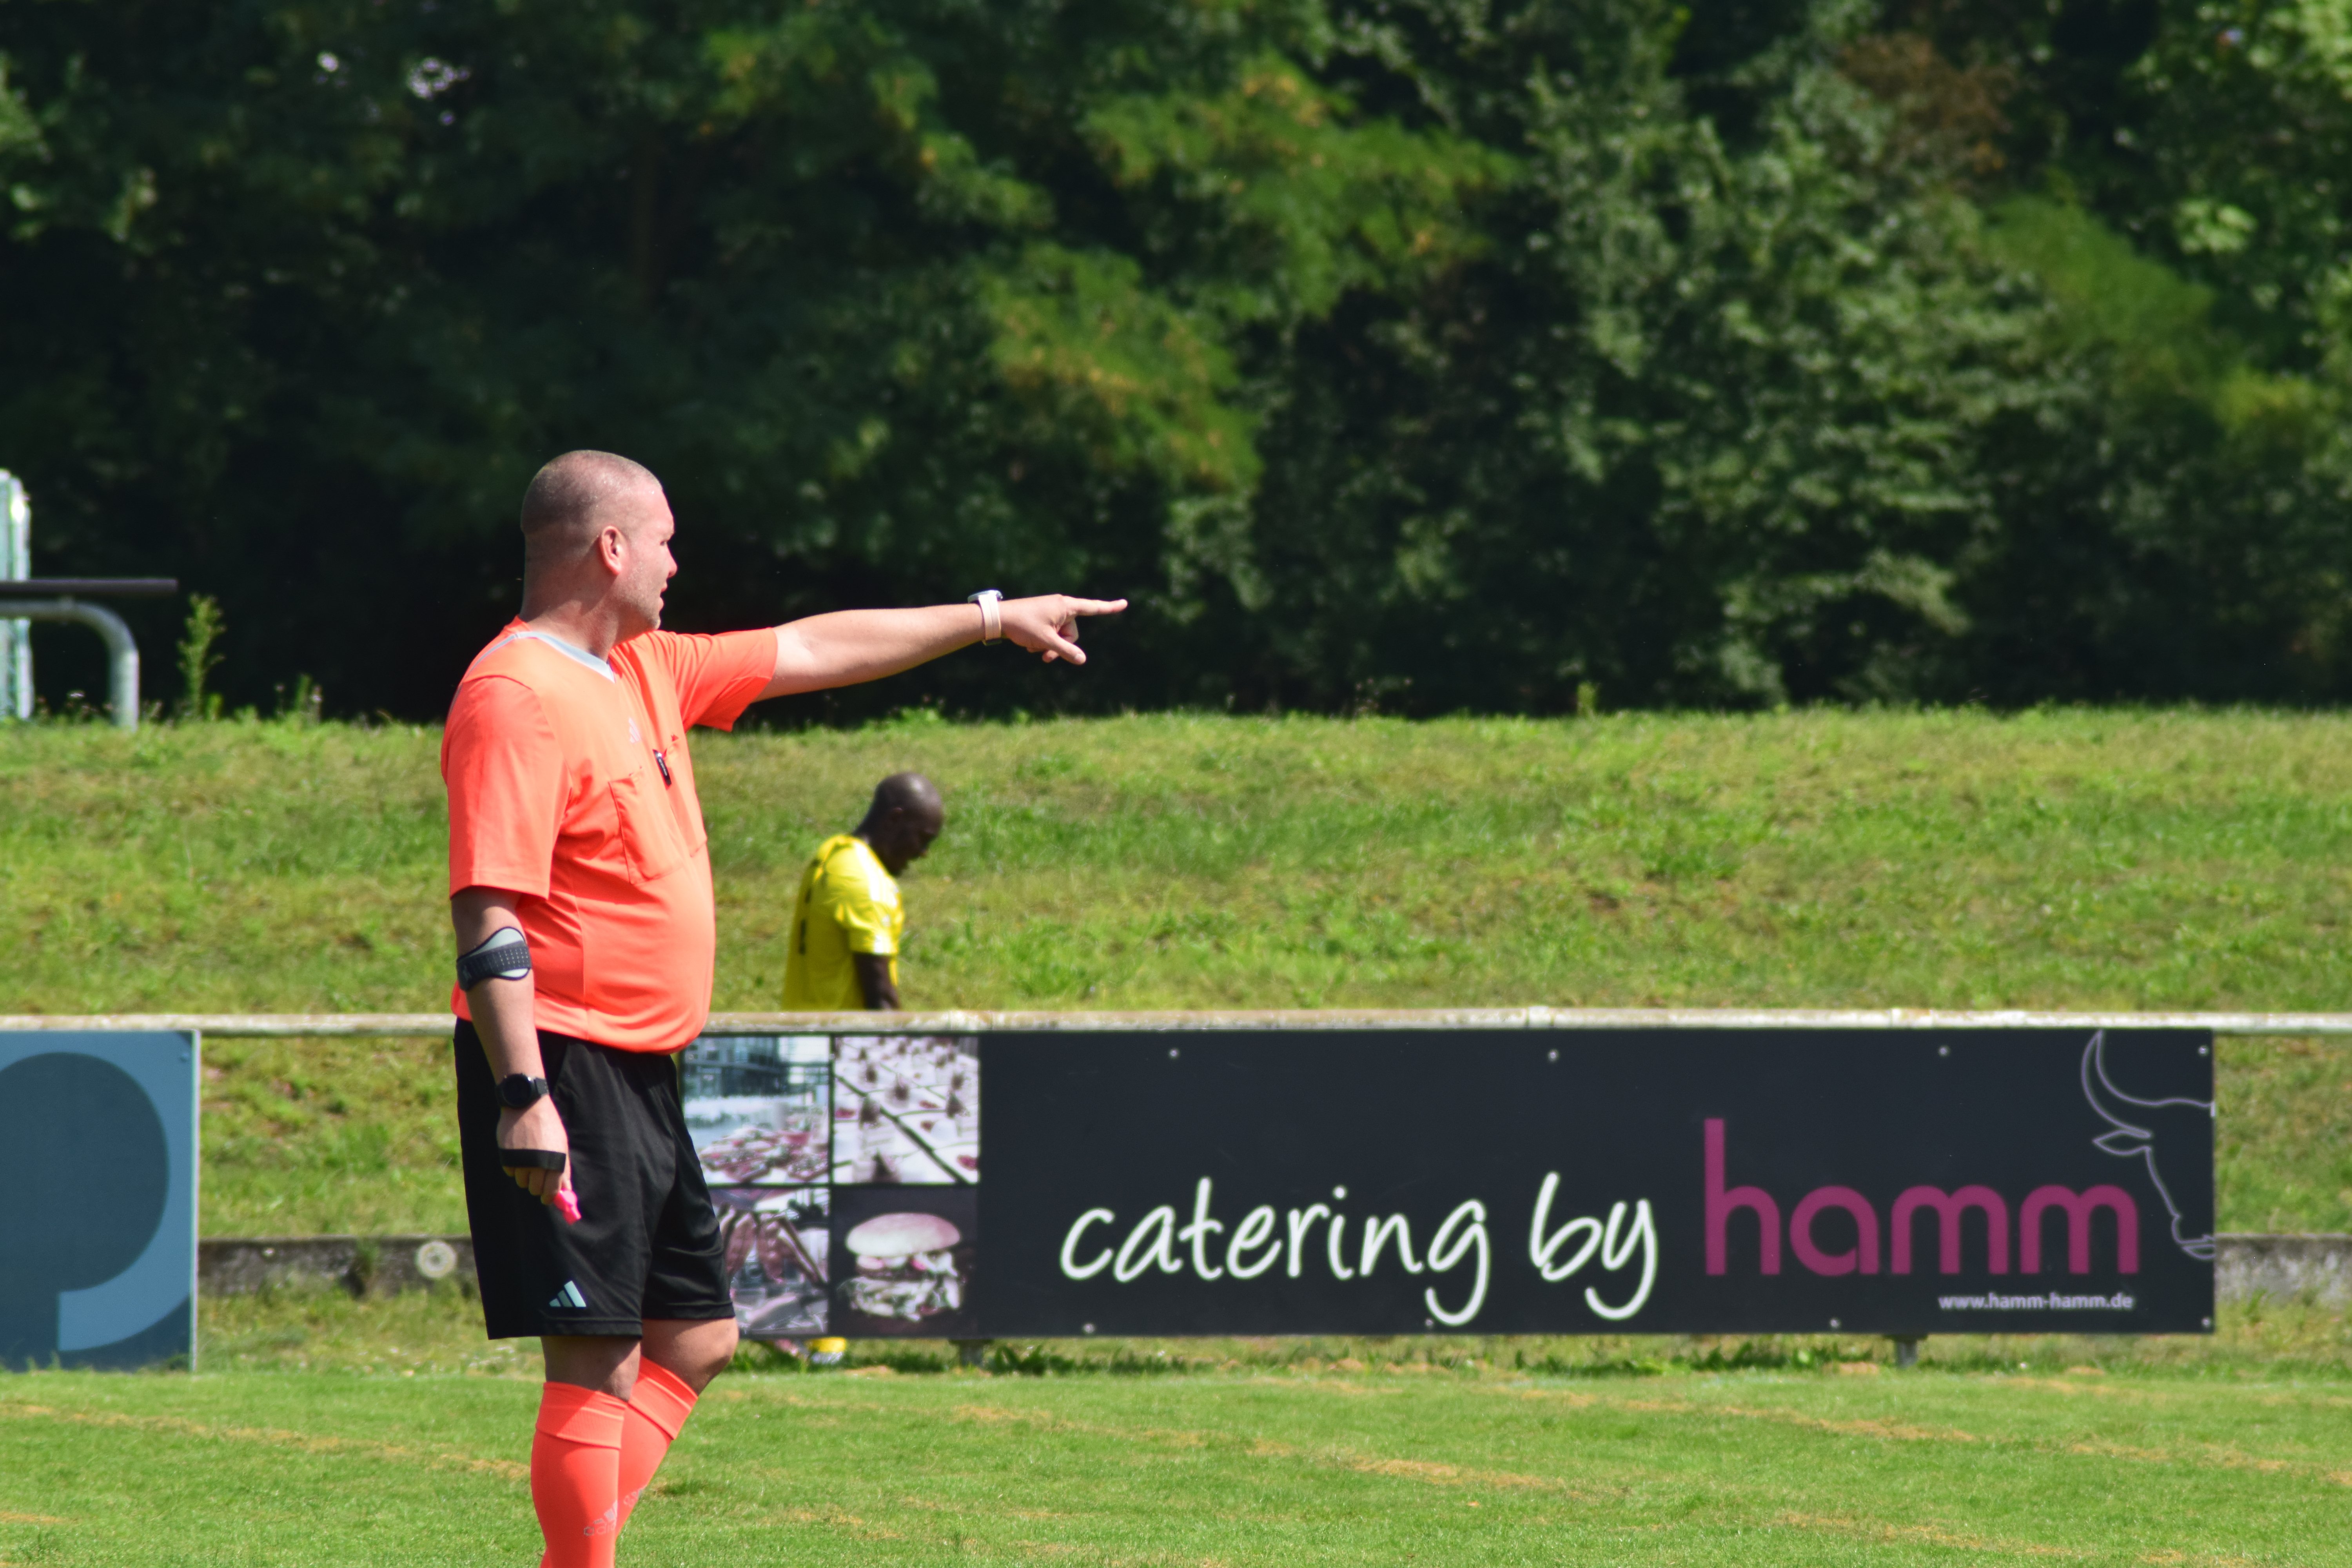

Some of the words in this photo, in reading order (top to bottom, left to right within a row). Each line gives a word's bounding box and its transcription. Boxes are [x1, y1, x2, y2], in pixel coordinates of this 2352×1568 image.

[1060, 1176, 1489, 1326] catering
[1529, 1172, 1657, 1319] by
[1704, 1118, 2138, 1275] hamm
[1938, 1291, 2134, 1310] www.hamm-hamm.de
